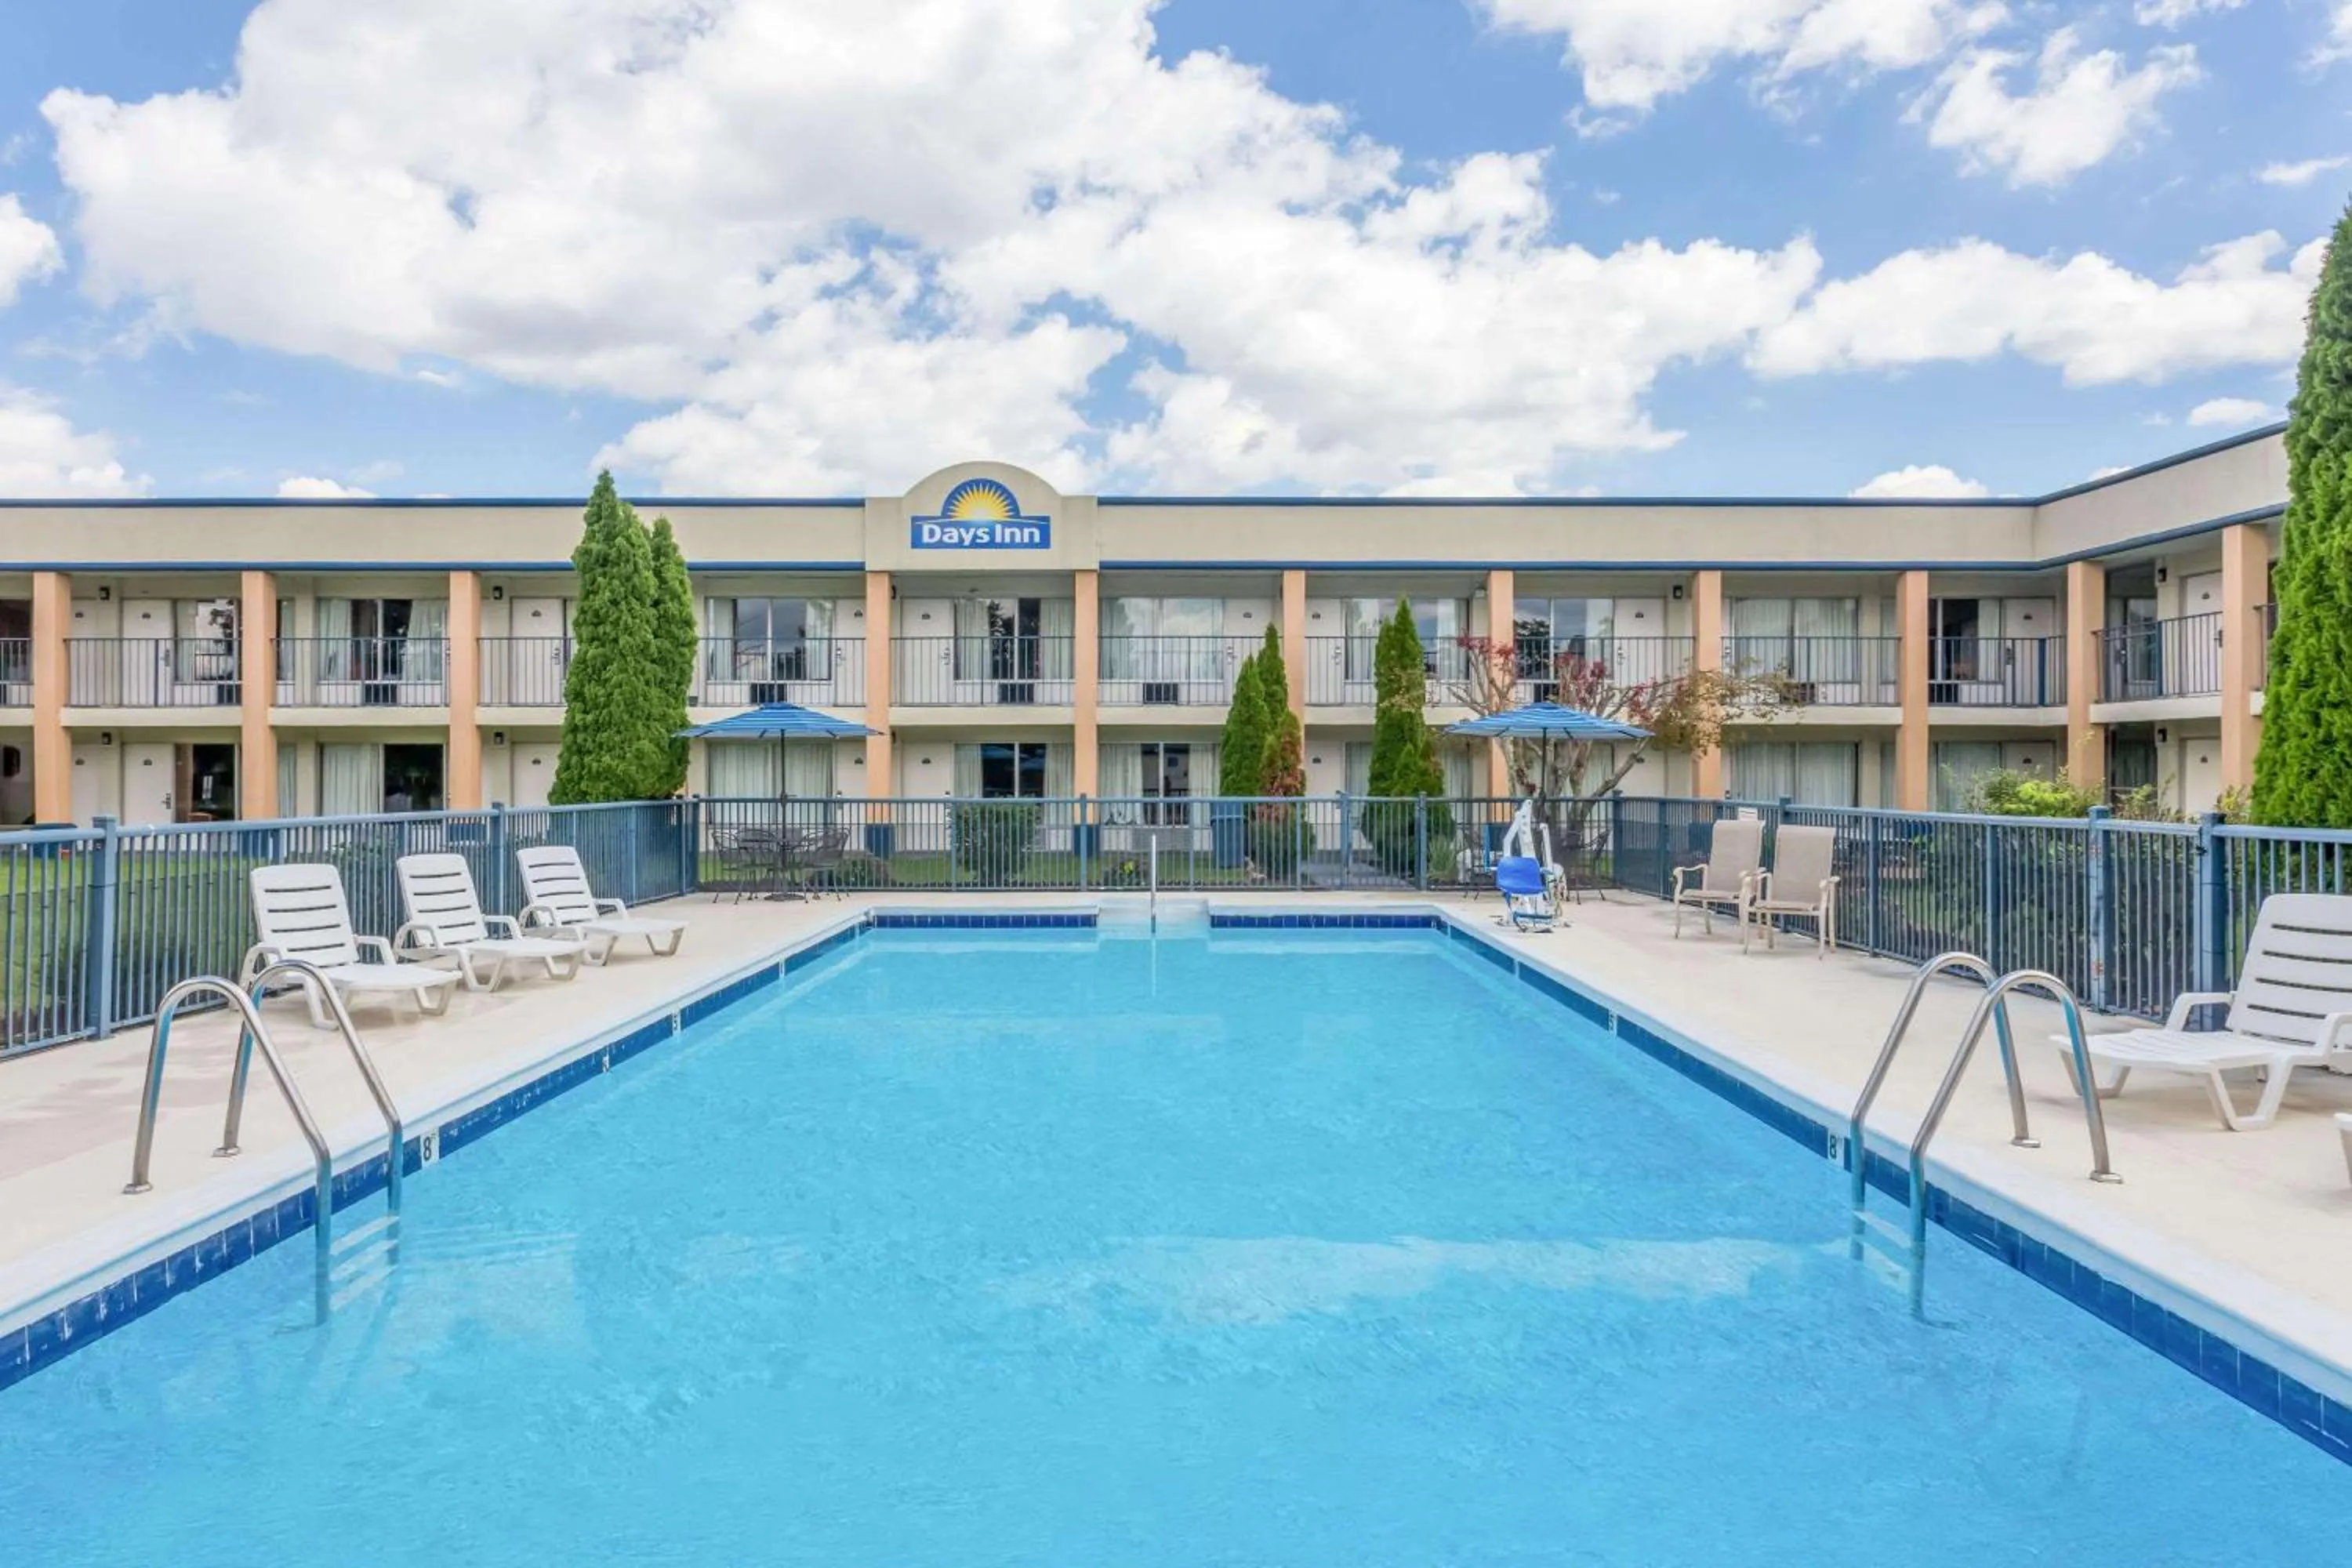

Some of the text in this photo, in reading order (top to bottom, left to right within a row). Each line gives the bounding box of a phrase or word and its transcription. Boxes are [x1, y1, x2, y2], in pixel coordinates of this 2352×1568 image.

[922, 524, 1040, 546] Days Inn
[423, 1136, 431, 1161] 8
[1829, 1134, 1837, 1160] 8
